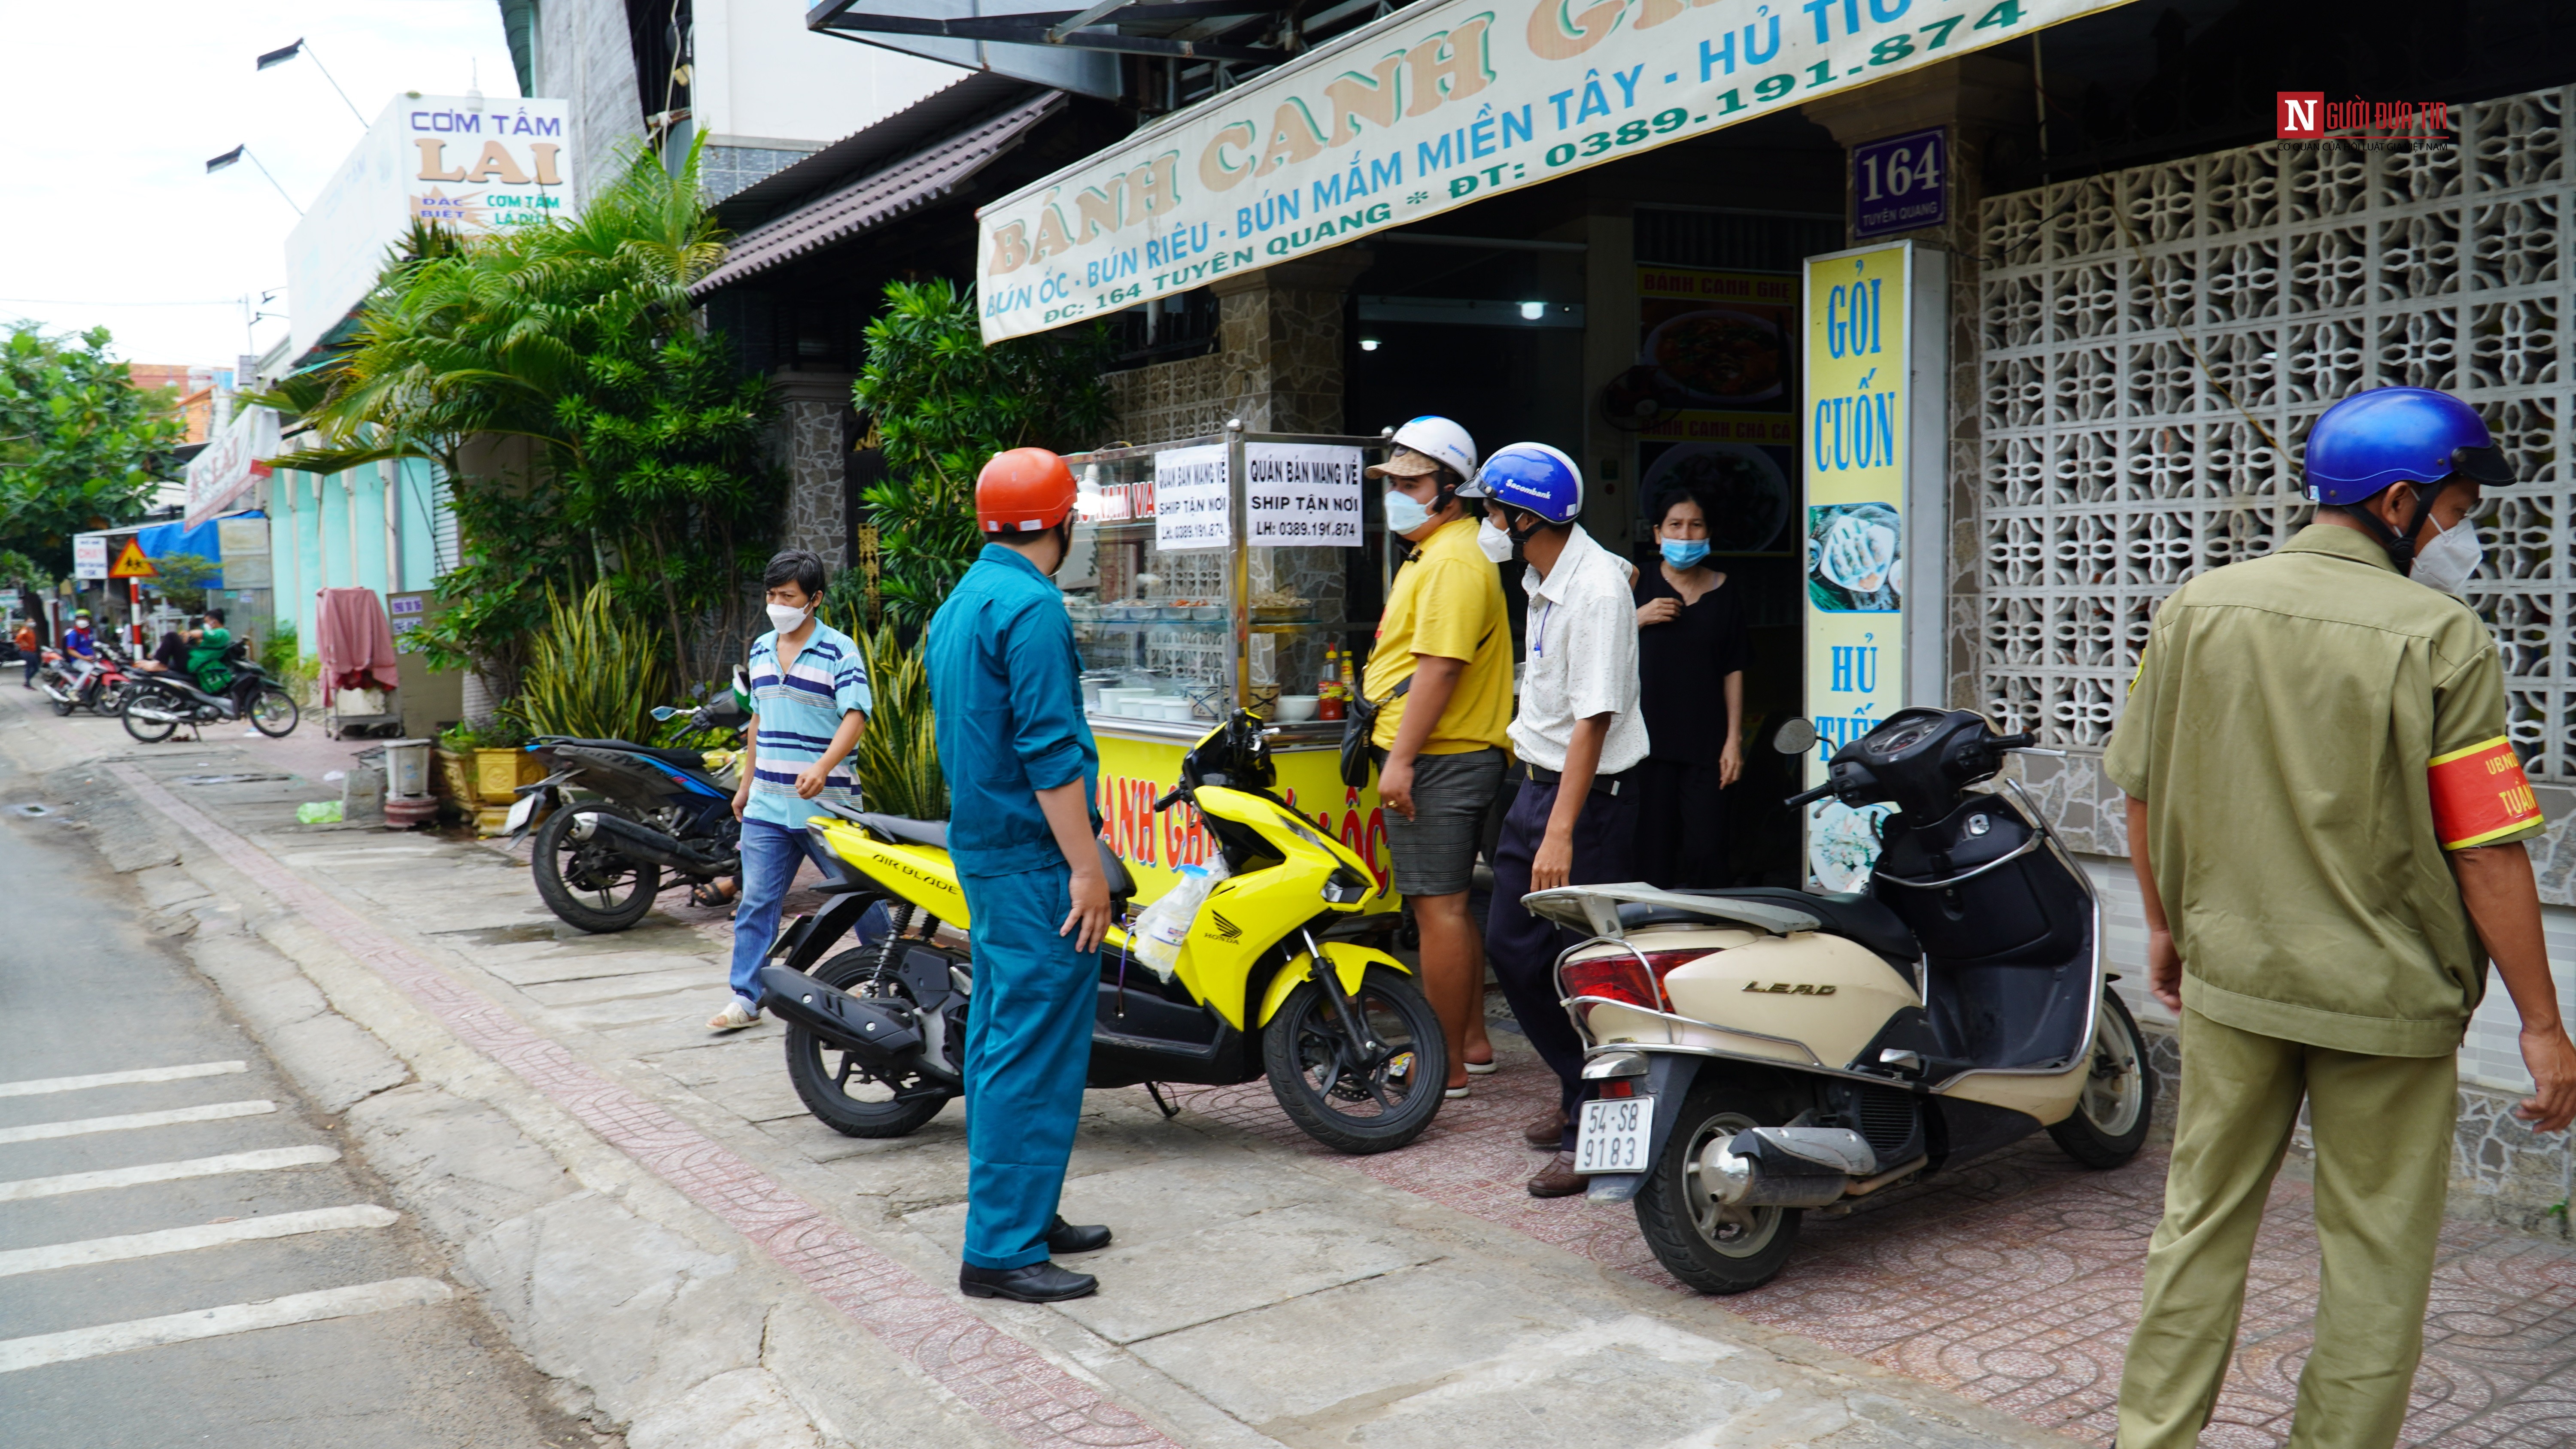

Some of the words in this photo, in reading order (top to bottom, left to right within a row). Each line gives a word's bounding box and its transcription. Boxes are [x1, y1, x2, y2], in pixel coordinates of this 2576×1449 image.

[410, 108, 480, 133] CƠM
[491, 106, 560, 136] TẤM
[988, 149, 1182, 276] BÁNH
[1199, 11, 1497, 192] CANH
[414, 138, 563, 185] LAI
[985, 284, 1032, 318] BÚN
[1039, 266, 1069, 304] ỐC
[1088, 247, 1138, 288] BÚN
[1146, 221, 1208, 269] RIÊU
[1237, 189, 1300, 239] BÚN
[1312, 150, 1403, 213] MẮM
[1418, 103, 1534, 177] MIỀN
[1549, 63, 1645, 131] TÂY
[1699, 5, 1780, 84] HỦ
[1862, 141, 1940, 203] 164
[1862, 207, 1897, 227] TUYÊN
[1899, 201, 1938, 220] QUANG
[1044, 303, 1084, 323] ĐC:
[1095, 282, 1143, 309] 164
[1152, 246, 1254, 291] TUYÊN
[1266, 202, 1391, 255] QUANG
[1448, 162, 1525, 199] ĐT:
[1643, 272, 1694, 293] BÁNH
[1701, 278, 1750, 296] CANH
[1757, 281, 1792, 302] GHẸ
[1827, 260, 1881, 359] GỎI
[1689, 421, 1730, 437] CANH
[1814, 367, 1895, 472] CUỐN
[1251, 454, 1283, 482] QUÁN
[1286, 455, 1309, 483] BÁN
[1312, 462, 1341, 484] MANG
[1252, 496, 1289, 509] SHIP
[1295, 494, 1328, 514] TẬN
[1334, 496, 1358, 512] NƠI
[1505, 479, 1552, 500] Sacombank
[1160, 501, 1180, 515] SHIP
[1184, 497, 1204, 517] TẬN
[1256, 521, 1276, 535] LH:
[1279, 522, 1355, 537] 0389.191.874
[1831, 633, 1877, 693] HỦ
[1095, 774, 1157, 868] ANH
[1164, 784, 1218, 870] GH
[873, 855, 899, 870] AIR
[902, 866, 962, 894] BLADE
[1204, 932, 1240, 945] HONDA
[1741, 980, 1838, 996] LEAD
[1589, 1103, 1638, 1134] 54-S8
[1584, 1137, 1635, 1167] 9183
